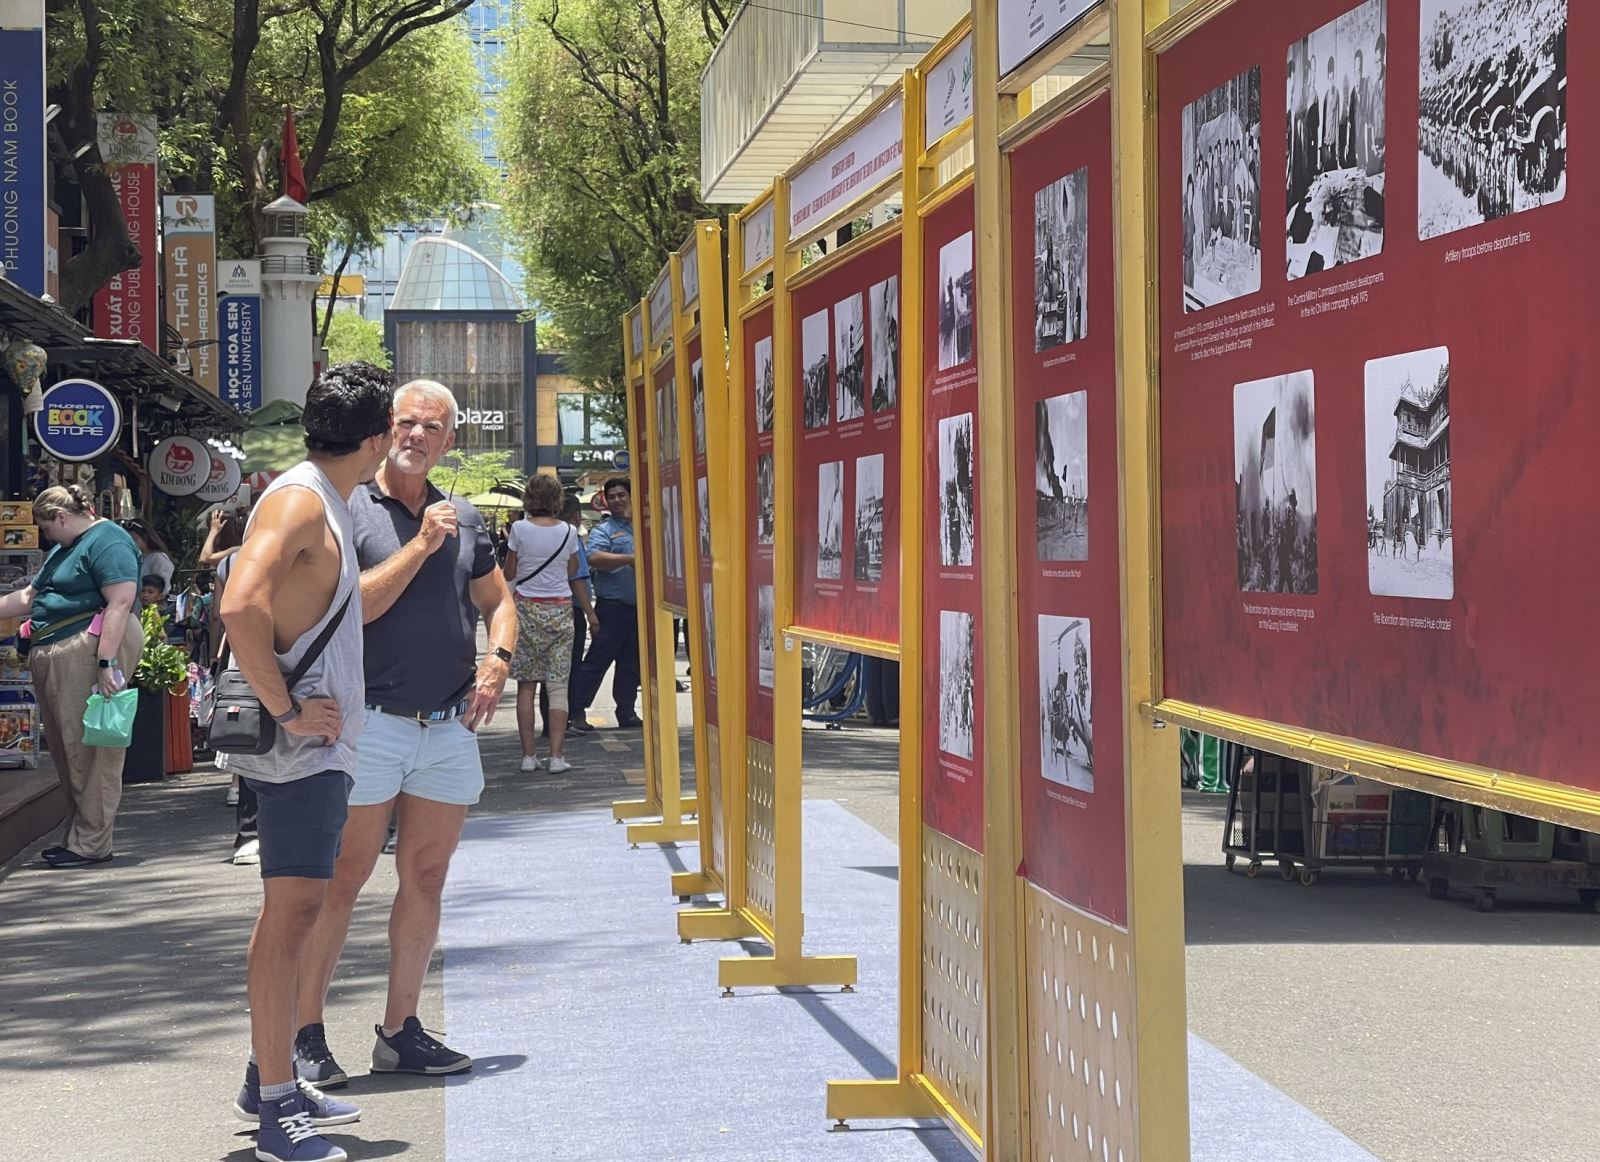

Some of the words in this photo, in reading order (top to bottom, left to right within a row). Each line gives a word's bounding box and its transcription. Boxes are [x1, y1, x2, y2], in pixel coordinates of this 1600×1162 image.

[4, 80, 18, 132] BOOK
[4, 140, 18, 182] NAM
[128, 171, 140, 216] HOUSE
[4, 190, 18, 270] PHUONG
[228, 302, 238, 329] SEN
[228, 333, 239, 364] HOA
[241, 302, 251, 371] UNIVERSITY
[228, 368, 242, 399] HỌC
[243, 374, 252, 398] SEN
[48, 409, 103, 426] BOOK
[48, 426, 104, 436] STORE
[160, 471, 175, 485] KIM
[176, 473, 197, 487] DONG
